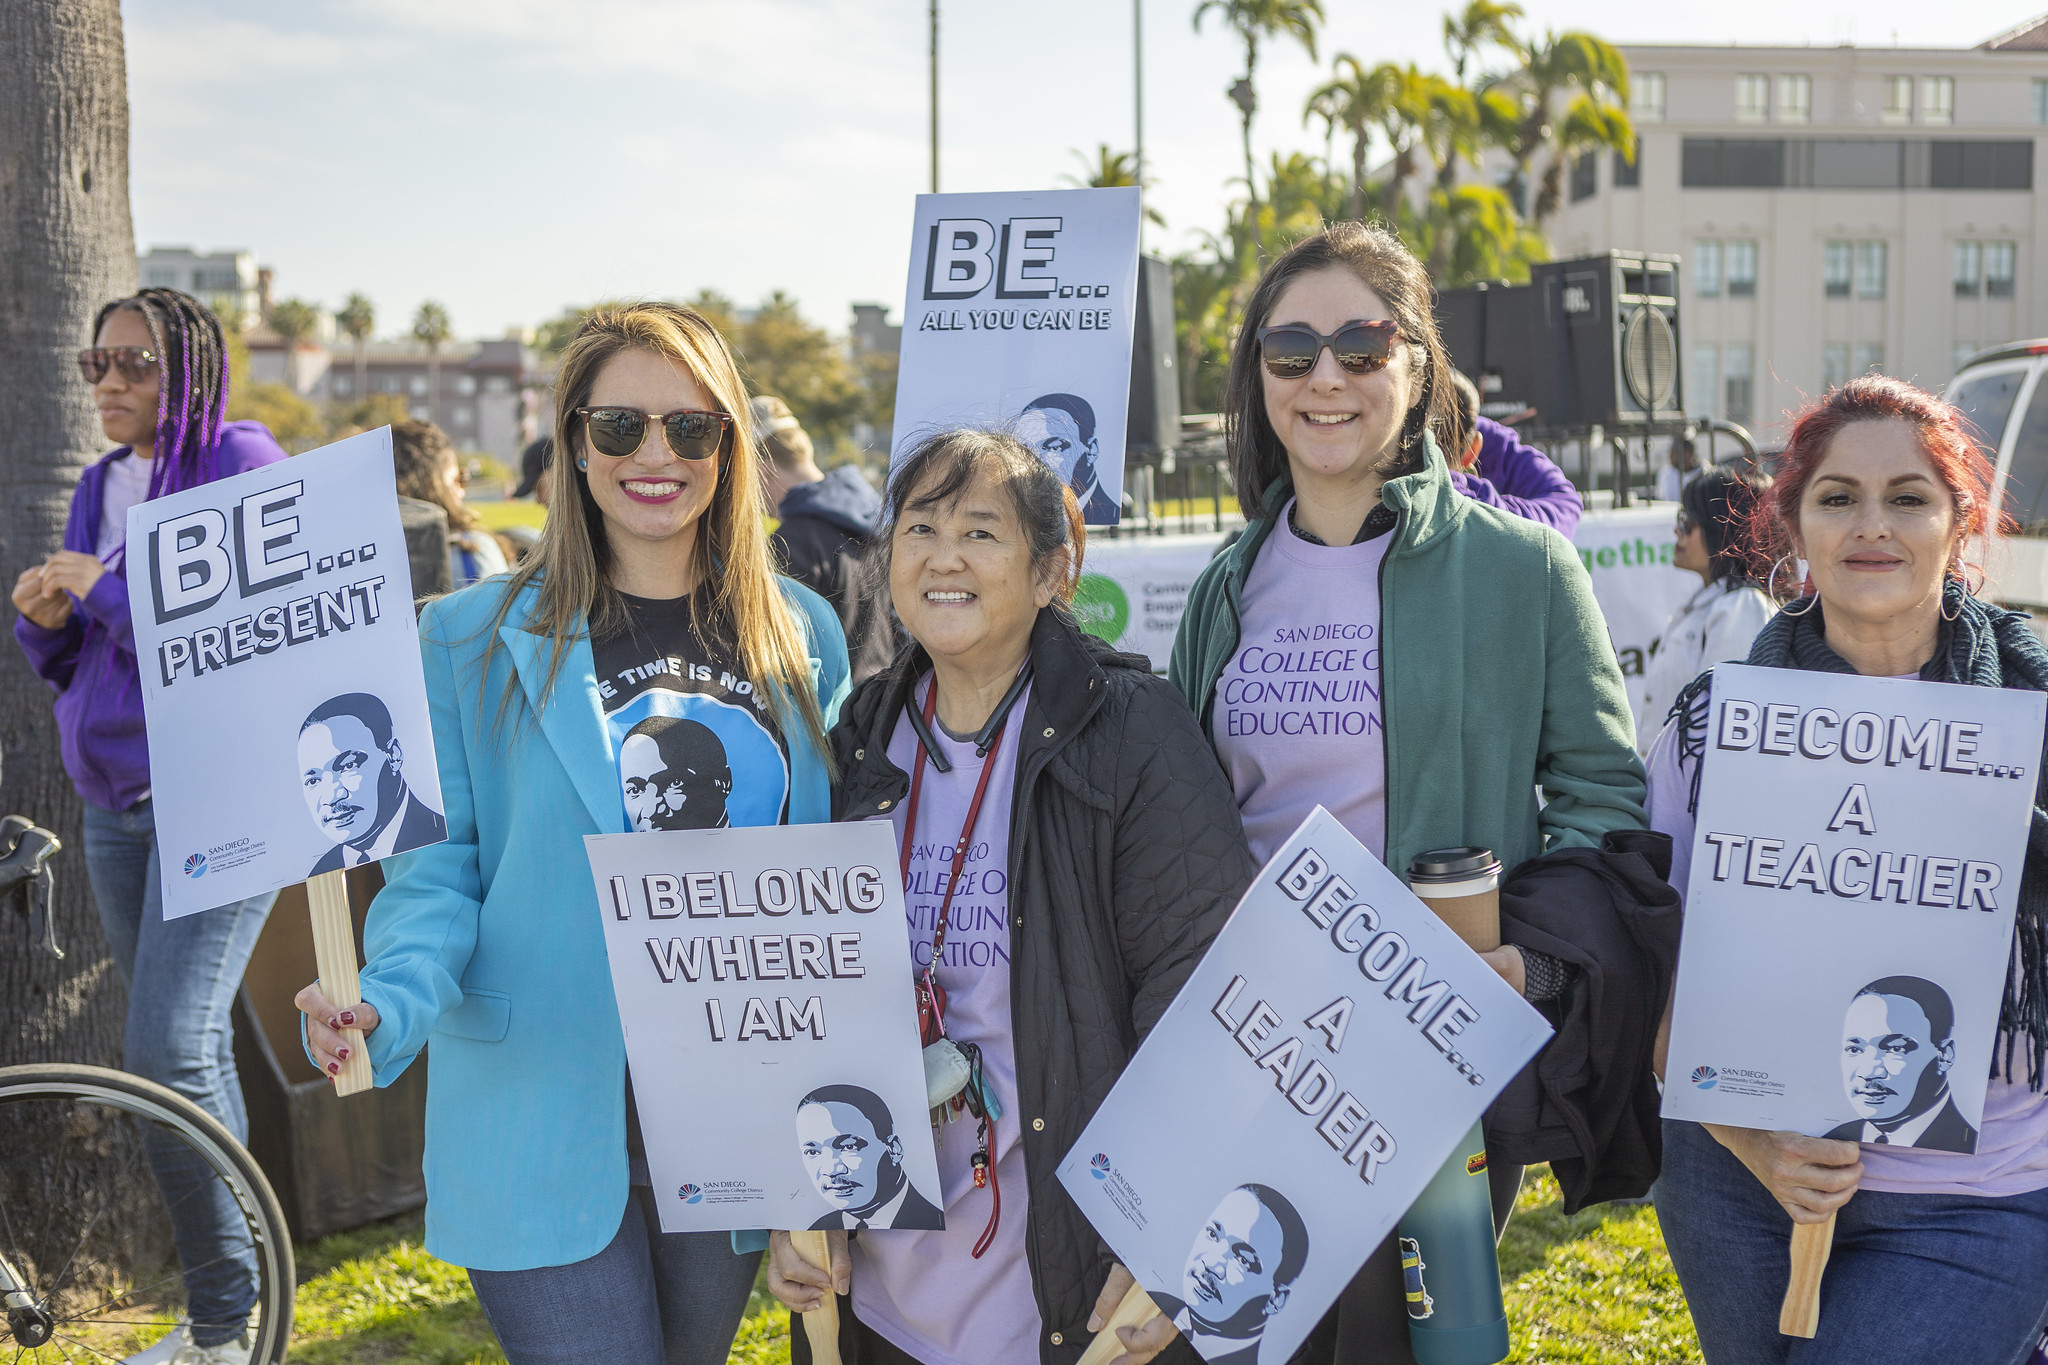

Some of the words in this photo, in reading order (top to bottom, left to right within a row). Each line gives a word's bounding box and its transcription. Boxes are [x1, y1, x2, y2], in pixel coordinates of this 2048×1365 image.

[923, 216, 1110, 300] BE...
[920, 309, 966, 331] ALL
[969, 309, 1019, 330] YOU
[1023, 309, 1075, 330] CAN
[1079, 308, 1111, 330] BE
[148, 479, 377, 626] BE...
[158, 575, 385, 687] PRESENT
[1273, 626, 1310, 643] SAN
[1313, 624, 1374, 641] DIEGO
[617, 656, 683, 686] TIME
[689, 663, 712, 681] IS
[1238, 646, 1358, 674] COLLEGE
[1224, 678, 1381, 705] CONTINUIN
[1716, 699, 2025, 780] BECOME...
[1826, 783, 1877, 835] A
[208, 845, 224, 856] SAN
[225, 837, 250, 851] DIEGO
[1705, 832, 2003, 912] TEACHER
[610, 875, 632, 921] I
[642, 865, 885, 920] BELONG
[645, 932, 866, 983] WHERE
[1275, 847, 1485, 1086] BECOME...
[705, 998, 726, 1042] I
[738, 996, 827, 1041] AM
[1304, 996, 1355, 1054] A
[1211, 974, 1398, 1185] LEADER
[1740, 1069, 1769, 1080] DIEGO
[720, 1180, 747, 1188] DIEGO
[1112, 1168, 1126, 1185] SAN
[1123, 1182, 1142, 1206] DIEGO
